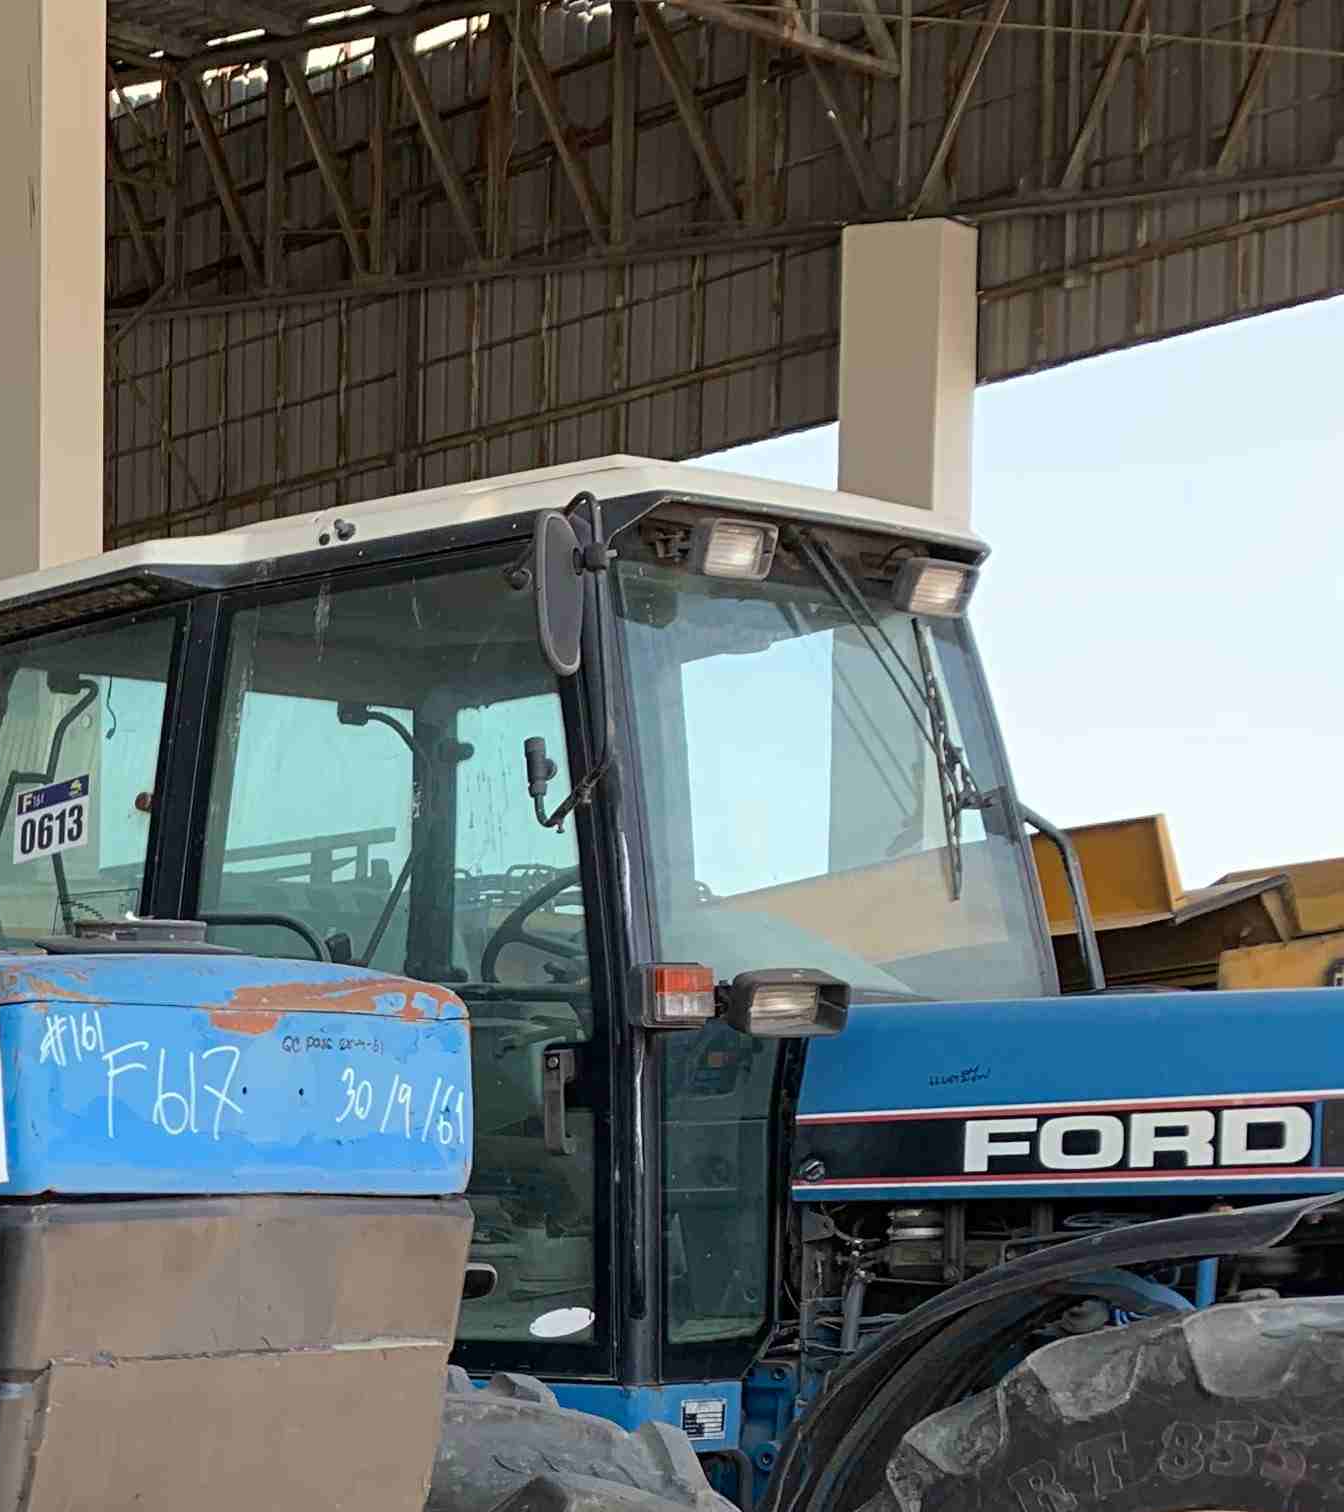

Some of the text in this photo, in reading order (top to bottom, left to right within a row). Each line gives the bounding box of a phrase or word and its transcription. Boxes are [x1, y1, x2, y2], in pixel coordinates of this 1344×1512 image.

[21, 804, 83, 854] 0613
[23, 793, 33, 812] F
[39, 1010, 105, 1066] #161
[102, 1040, 245, 1141] F617
[962, 1105, 1313, 1174] FORD
